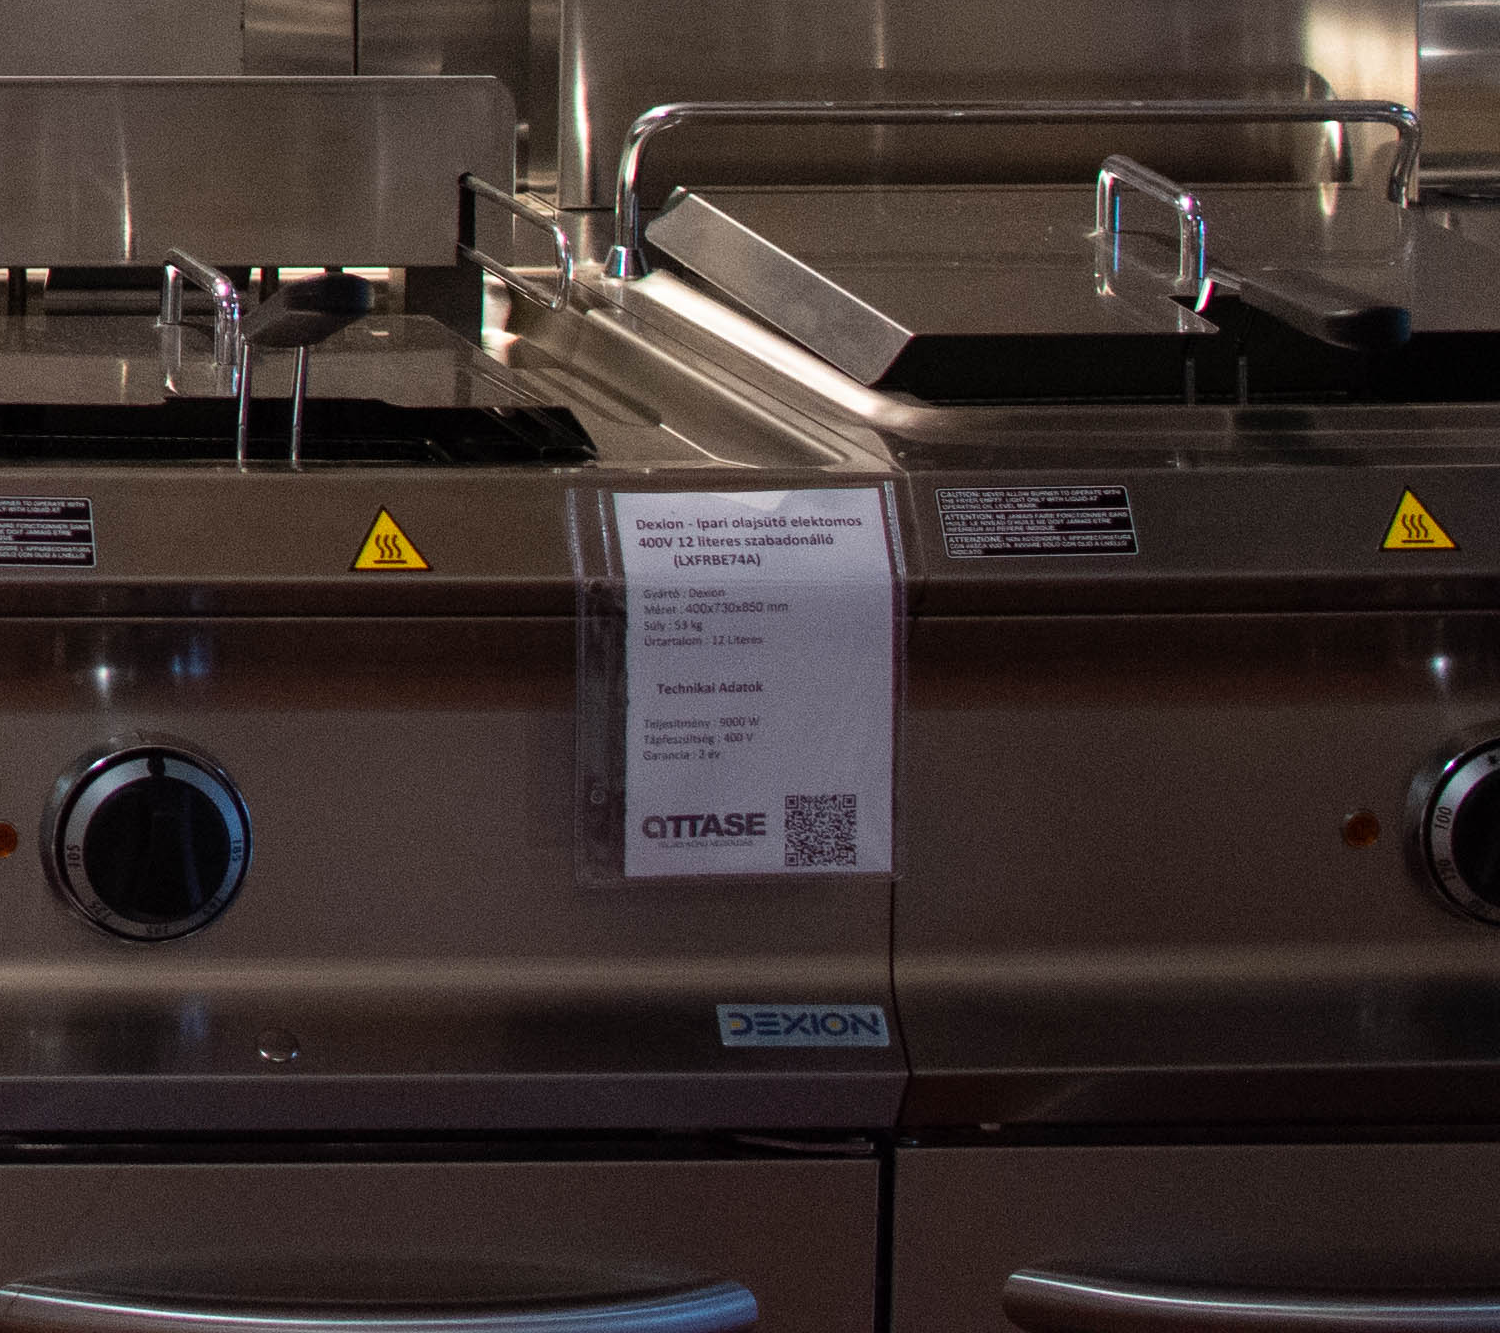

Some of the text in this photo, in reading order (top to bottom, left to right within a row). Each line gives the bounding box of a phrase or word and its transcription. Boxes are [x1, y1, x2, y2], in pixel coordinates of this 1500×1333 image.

[636, 519, 685, 531] Dexion
[696, 518, 729, 532] Ipari
[638, 533, 834, 549] 400V 12 literes szabadonálló
[673, 552, 762, 568] (LXFRBE74A)
[657, 680, 764, 695] Technikai Adatok
[1434, 806, 1453, 831] 100
[727, 1012, 882, 1036] DEXION
